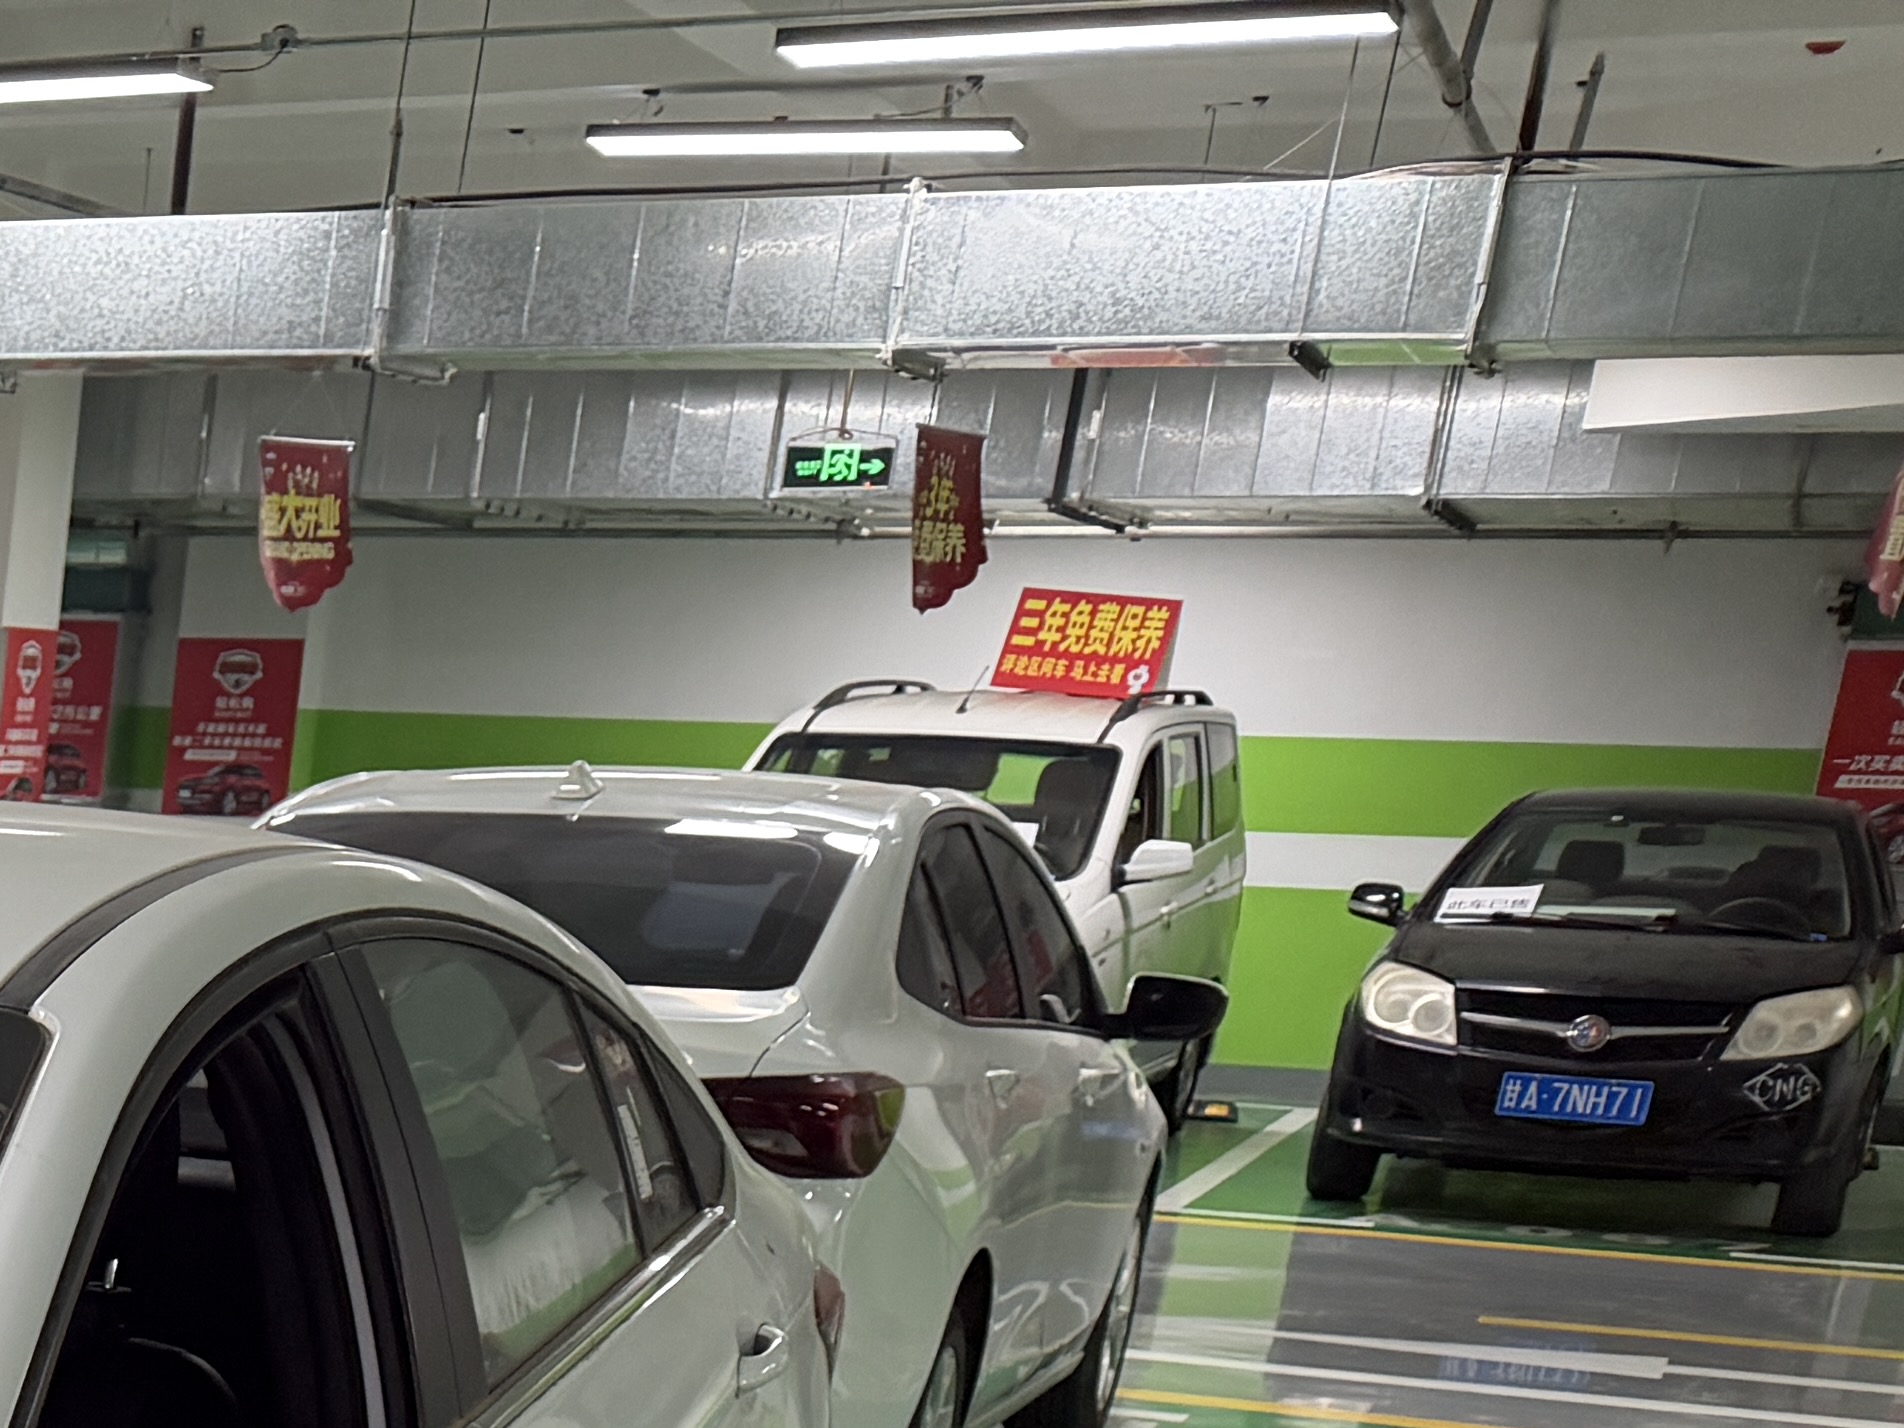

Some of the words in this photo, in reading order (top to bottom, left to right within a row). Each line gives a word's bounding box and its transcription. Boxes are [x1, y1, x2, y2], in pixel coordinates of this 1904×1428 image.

[1010, 597, 1170, 661] 三年免费保养
[1753, 1074, 1815, 1104] CNG
